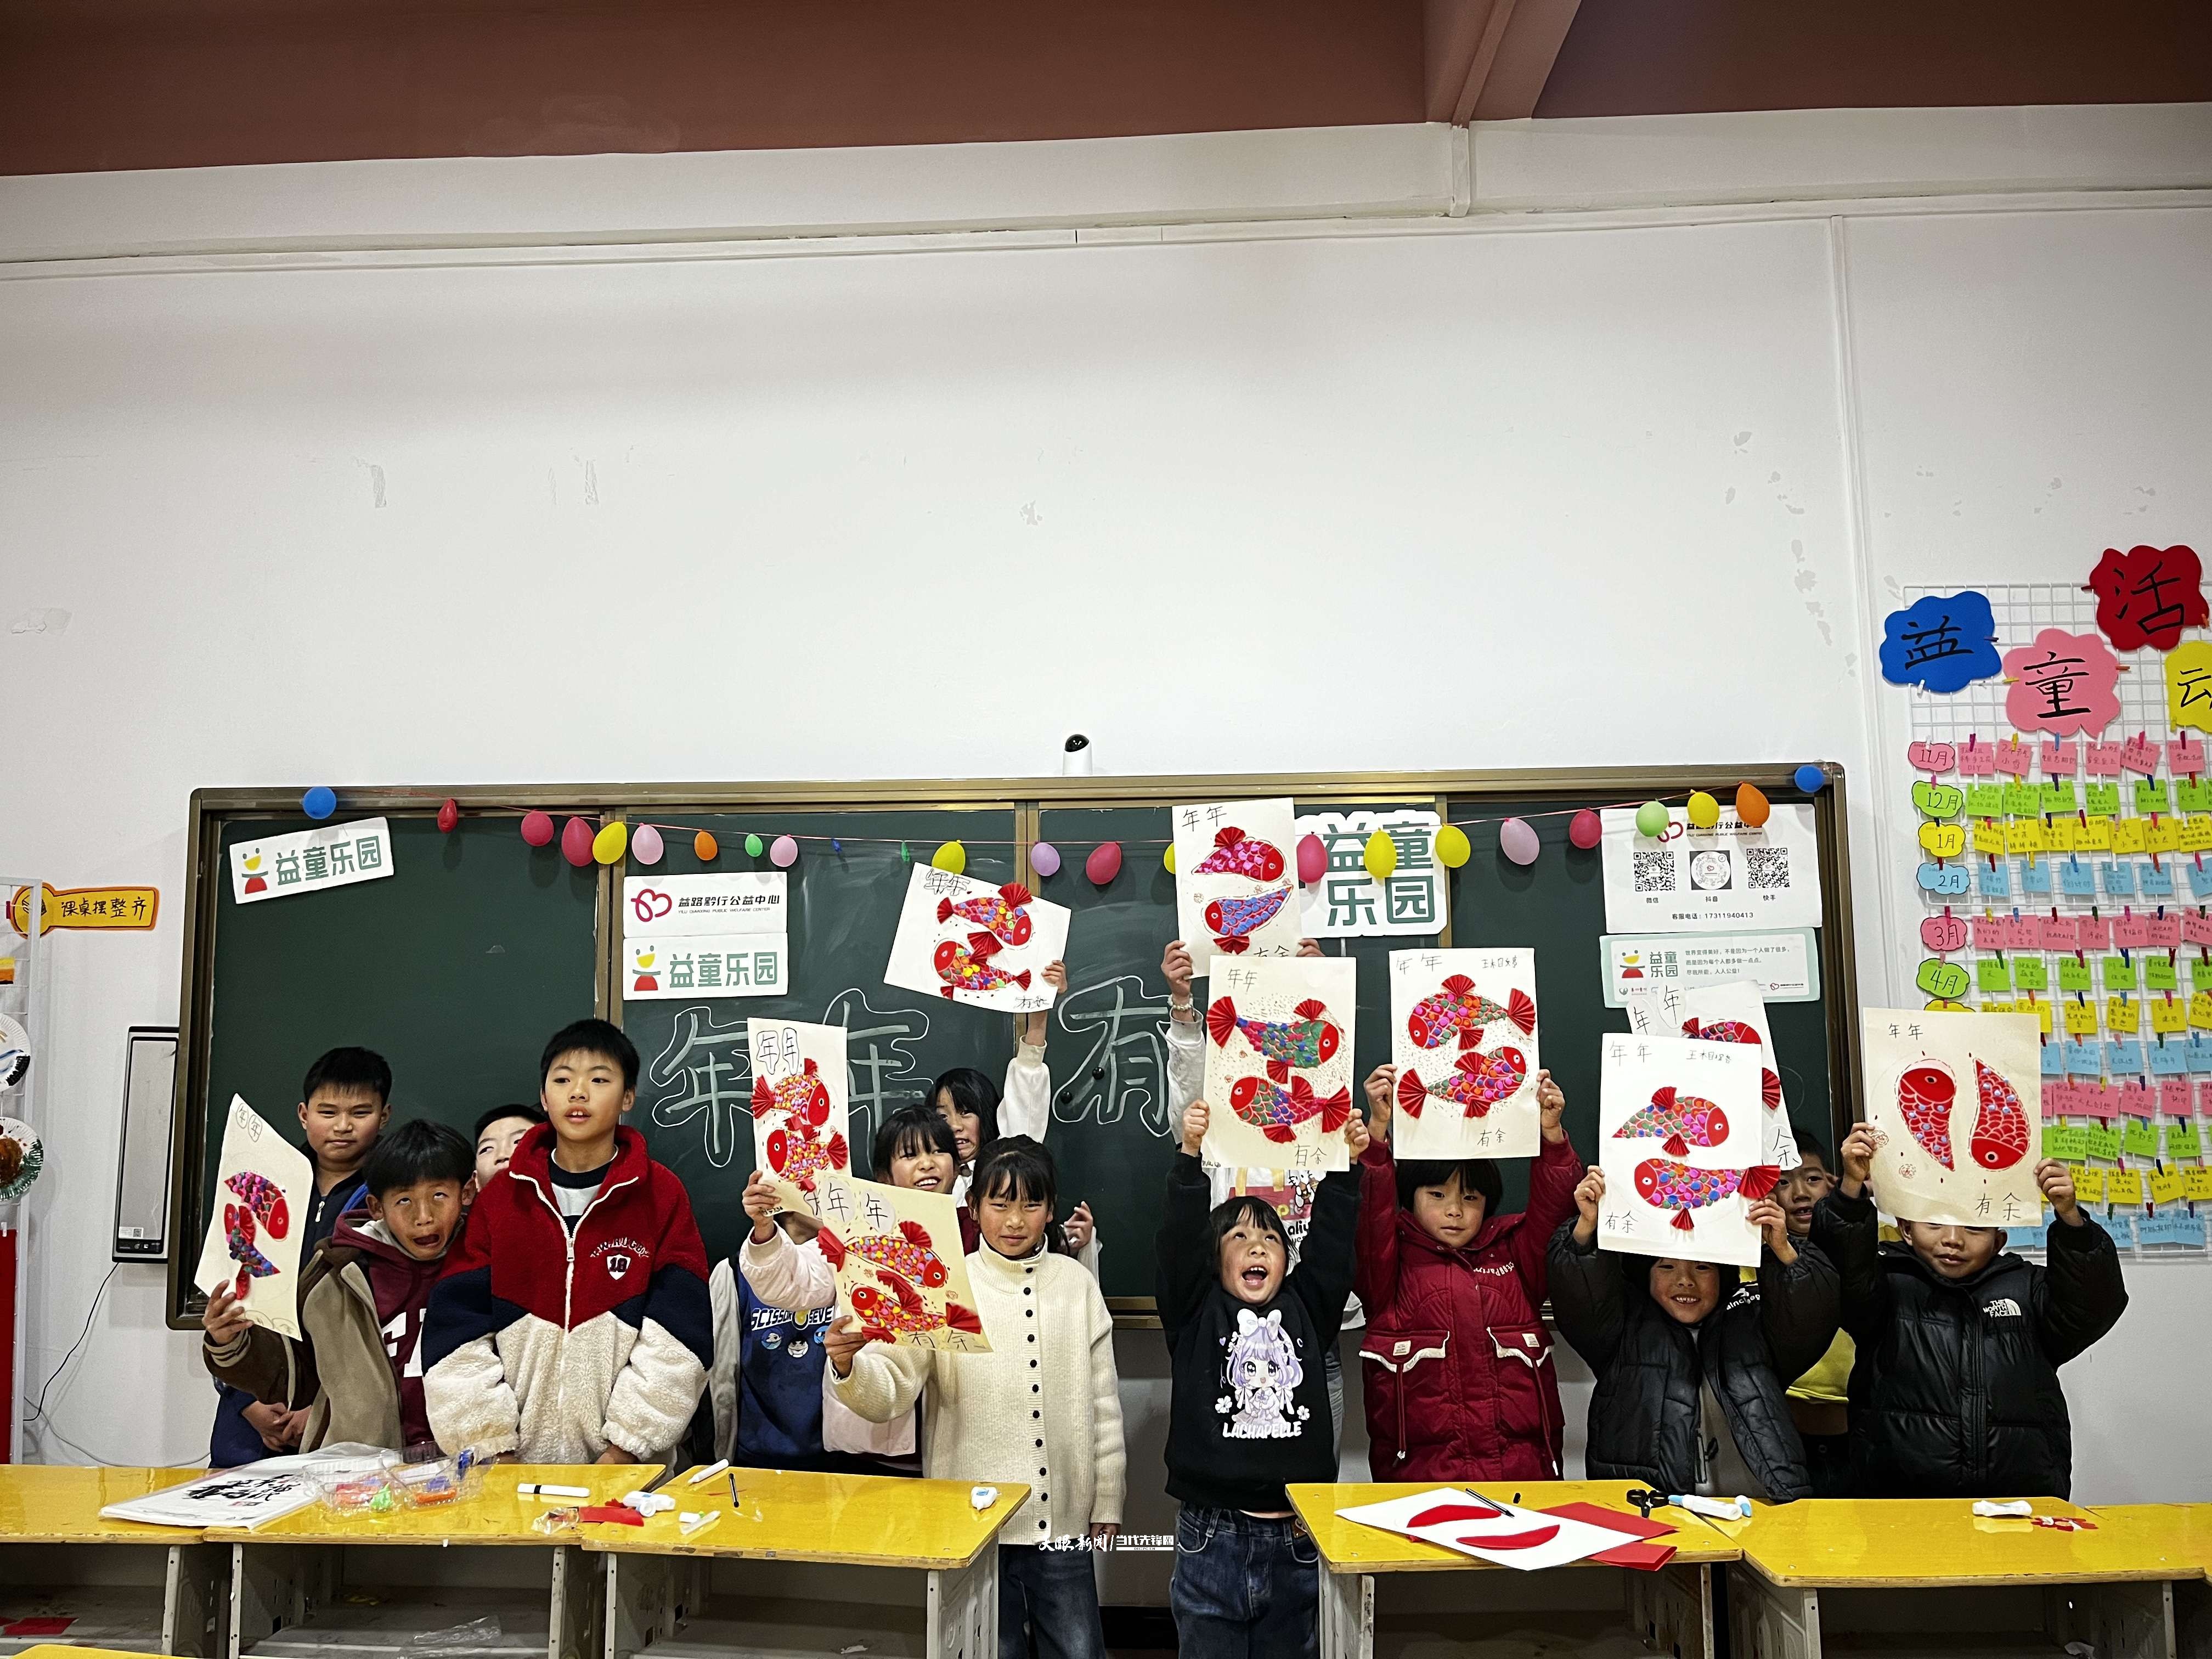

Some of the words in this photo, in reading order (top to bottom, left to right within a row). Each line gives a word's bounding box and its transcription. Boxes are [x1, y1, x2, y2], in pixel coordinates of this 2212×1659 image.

[2112, 561, 2186, 635] 活
[1901, 615, 1974, 671] 益
[2023, 651, 2091, 719] 童
[1918, 749, 1947, 766] 11月
[1927, 792, 1958, 810] 12月
[1182, 806, 1227, 832] 年年
[1323, 821, 1433, 872] 益童
[1936, 833, 1955, 849] 1月
[275, 836, 382, 885] 益童乐园
[1938, 874, 1959, 889] 2月
[61, 896, 147, 921] 课桌摆整齐
[678, 895, 780, 907] 益路黔行公益中心
[1328, 878, 1435, 926] 乐园
[1934, 924, 1960, 946] 3月
[669, 951, 778, 988] 益童乐园
[1396, 953, 1442, 975] 年年
[1650, 951, 1677, 964] 益童
[1227, 968, 1259, 992] 年年
[1650, 964, 1679, 978] 乐园
[1930, 970, 1958, 994] 4月
[1633, 986, 1681, 1035] 年年
[1888, 1023, 1923, 1041] 年年
[758, 1030, 798, 1075] 年年
[1610, 1041, 1652, 1066] 年年
[1477, 1127, 1506, 1147] 有余
[1772, 1128, 1802, 1167] 余
[827, 1182, 888, 1228] 年年
[1974, 1192, 2022, 1222] 有余
[1605, 1210, 1639, 1234] 有余
[1983, 1303, 2008, 1313] NORTH
[1222, 1421, 1302, 1438] LACHAPELLE
